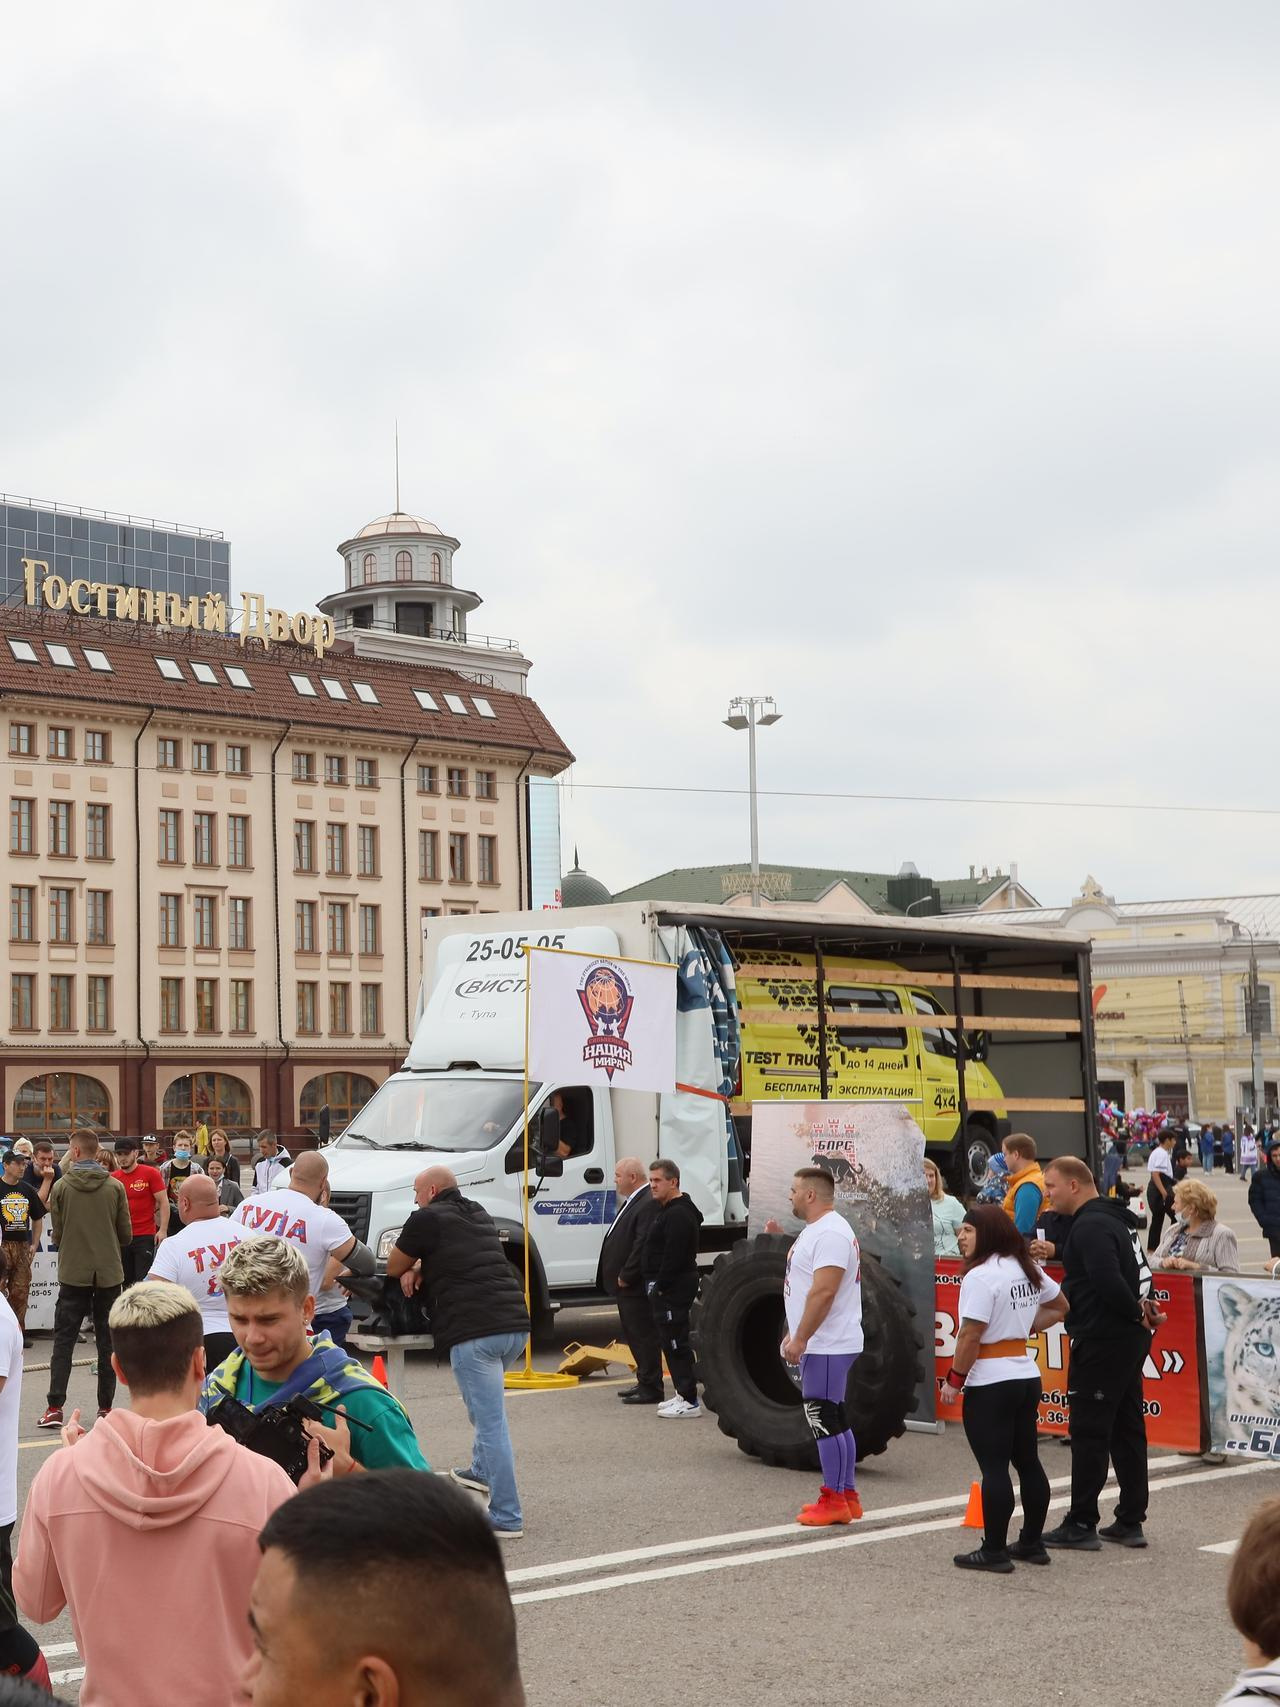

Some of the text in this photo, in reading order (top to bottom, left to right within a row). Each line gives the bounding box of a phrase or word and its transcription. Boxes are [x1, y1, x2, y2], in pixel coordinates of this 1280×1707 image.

[21, 557, 337, 659] Гостиный Двор
[466, 934, 566, 962] 25-0505
[464, 979, 531, 995] ВИСТ
[471, 1010, 498, 1021] Тула
[584, 1043, 631, 1063] НАЦИЯ
[746, 1051, 832, 1068] TEST TRUCK
[595, 1057, 624, 1069] МИРА
[846, 1058, 904, 1071] до 14 дней
[765, 1082, 914, 1097] БЕСПЛАТНЯ ЭКСПЛУАТАЦИЯ
[818, 1140, 853, 1151] БПРС
[241, 1204, 308, 1244] ТУЛА
[188, 1235, 242, 1274] ТУ
